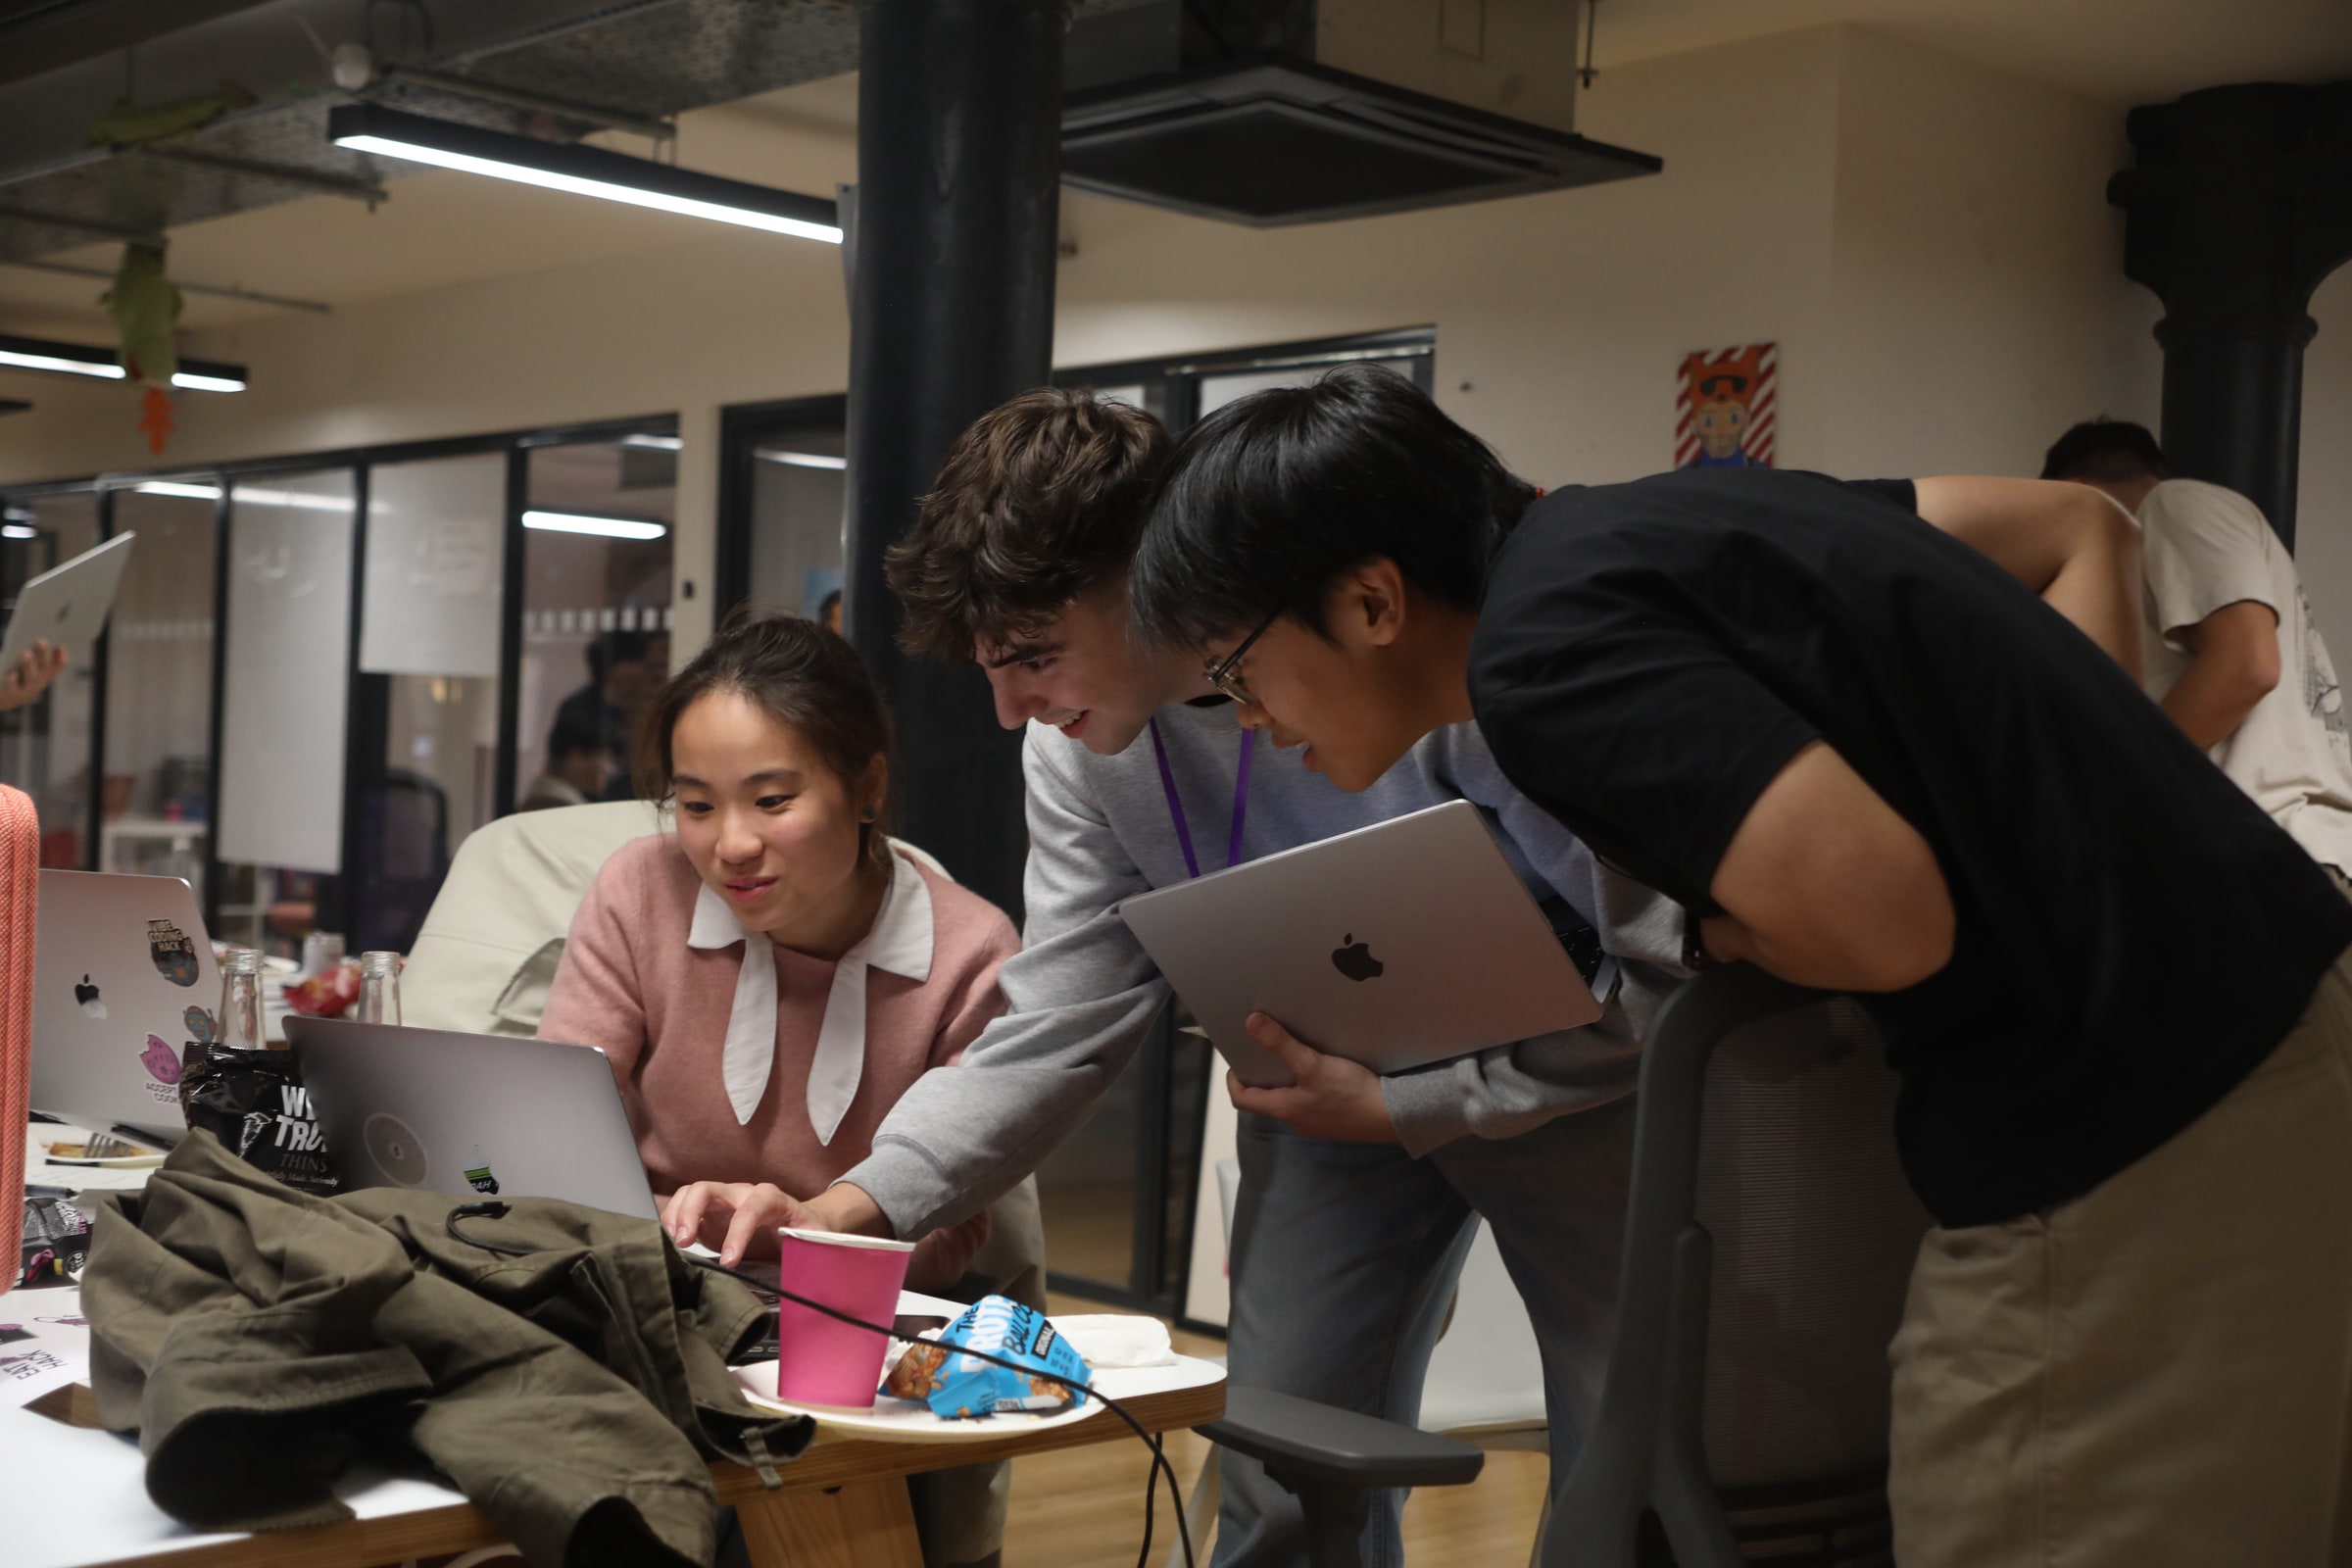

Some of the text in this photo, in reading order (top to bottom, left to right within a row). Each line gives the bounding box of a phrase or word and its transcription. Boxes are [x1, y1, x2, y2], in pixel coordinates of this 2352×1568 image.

[149, 930, 183, 942] CODING
[157, 941, 181, 951] HACK
[154, 1093, 179, 1103] COOK
[274, 1114, 327, 1153] TRU
[280, 1153, 328, 1173] THINS
[956, 1305, 979, 1334] THE
[1034, 1325, 1055, 1357] ORIGINAL
[20, 1349, 69, 1370] HACK
[3, 1362, 41, 1380] EAT
